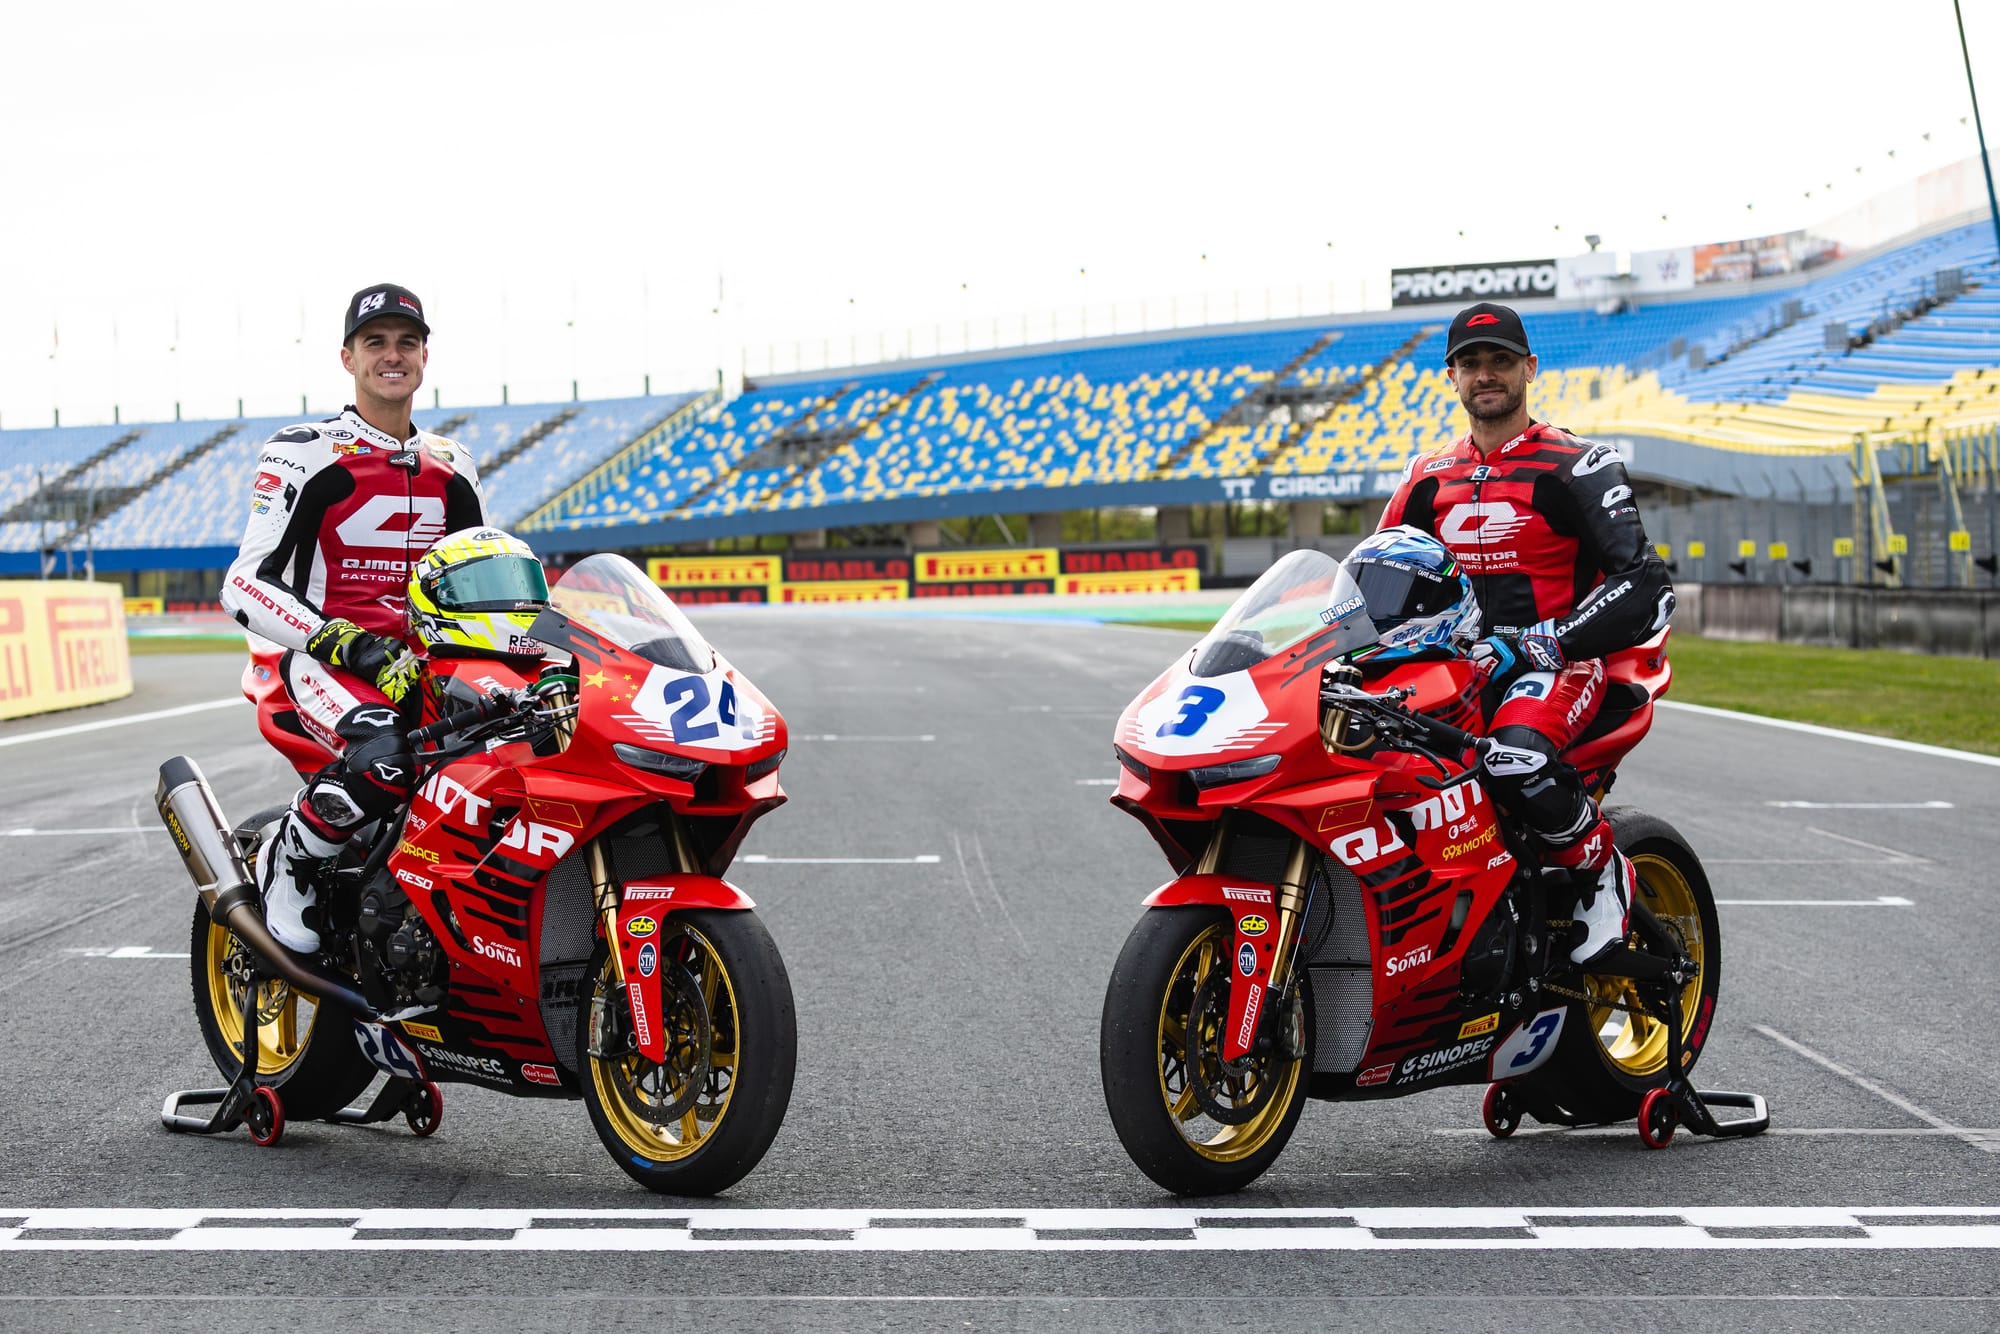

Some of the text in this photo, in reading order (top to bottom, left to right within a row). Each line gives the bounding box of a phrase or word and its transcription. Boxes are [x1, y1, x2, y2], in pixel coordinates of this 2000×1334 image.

[1392, 265, 1556, 299] PROFORTO
[358, 291, 386, 318] 24
[350, 419, 398, 446] MACNA
[1586, 444, 1618, 467] 4S
[1473, 466, 1488, 479] 3
[1220, 478, 1255, 498] TT
[1268, 474, 1364, 497] CIRCUIT
[342, 558, 417, 572] QJMOT
[658, 560, 770, 581] PIRELLI
[787, 559, 909, 581] DIABLO
[926, 554, 1046, 577] PIRELLI
[1065, 550, 1198, 573] DIABLO
[341, 573, 405, 583] FACTORY
[232, 576, 313, 635] QJMOTOR
[1320, 596, 1364, 624] DE ROSA
[1555, 580, 1633, 638] QJMOTOR
[662, 675, 755, 745] 24
[1156, 685, 1226, 738] 3
[167, 812, 191, 851] ARROW
[1329, 778, 1483, 866] QJMOT
[1487, 850, 1512, 870] RES
[395, 867, 434, 891] RESO
[624, 886, 675, 900] PIRELLI
[1221, 886, 1272, 904] PIRELLI
[629, 917, 655, 933] sbs
[1241, 915, 1267, 931] sbs
[640, 954, 655, 967] STM
[1240, 953, 1255, 967] STM
[630, 984, 651, 1045] BRAKING
[1239, 984, 1261, 1047] BRAKING
[407, 1024, 443, 1041] PIRELLI
[1509, 1012, 1560, 1068] 3
[355, 1021, 424, 1080] 24
[428, 1046, 505, 1075] SINOPEC
[1417, 1035, 1495, 1070] SINOPEC
